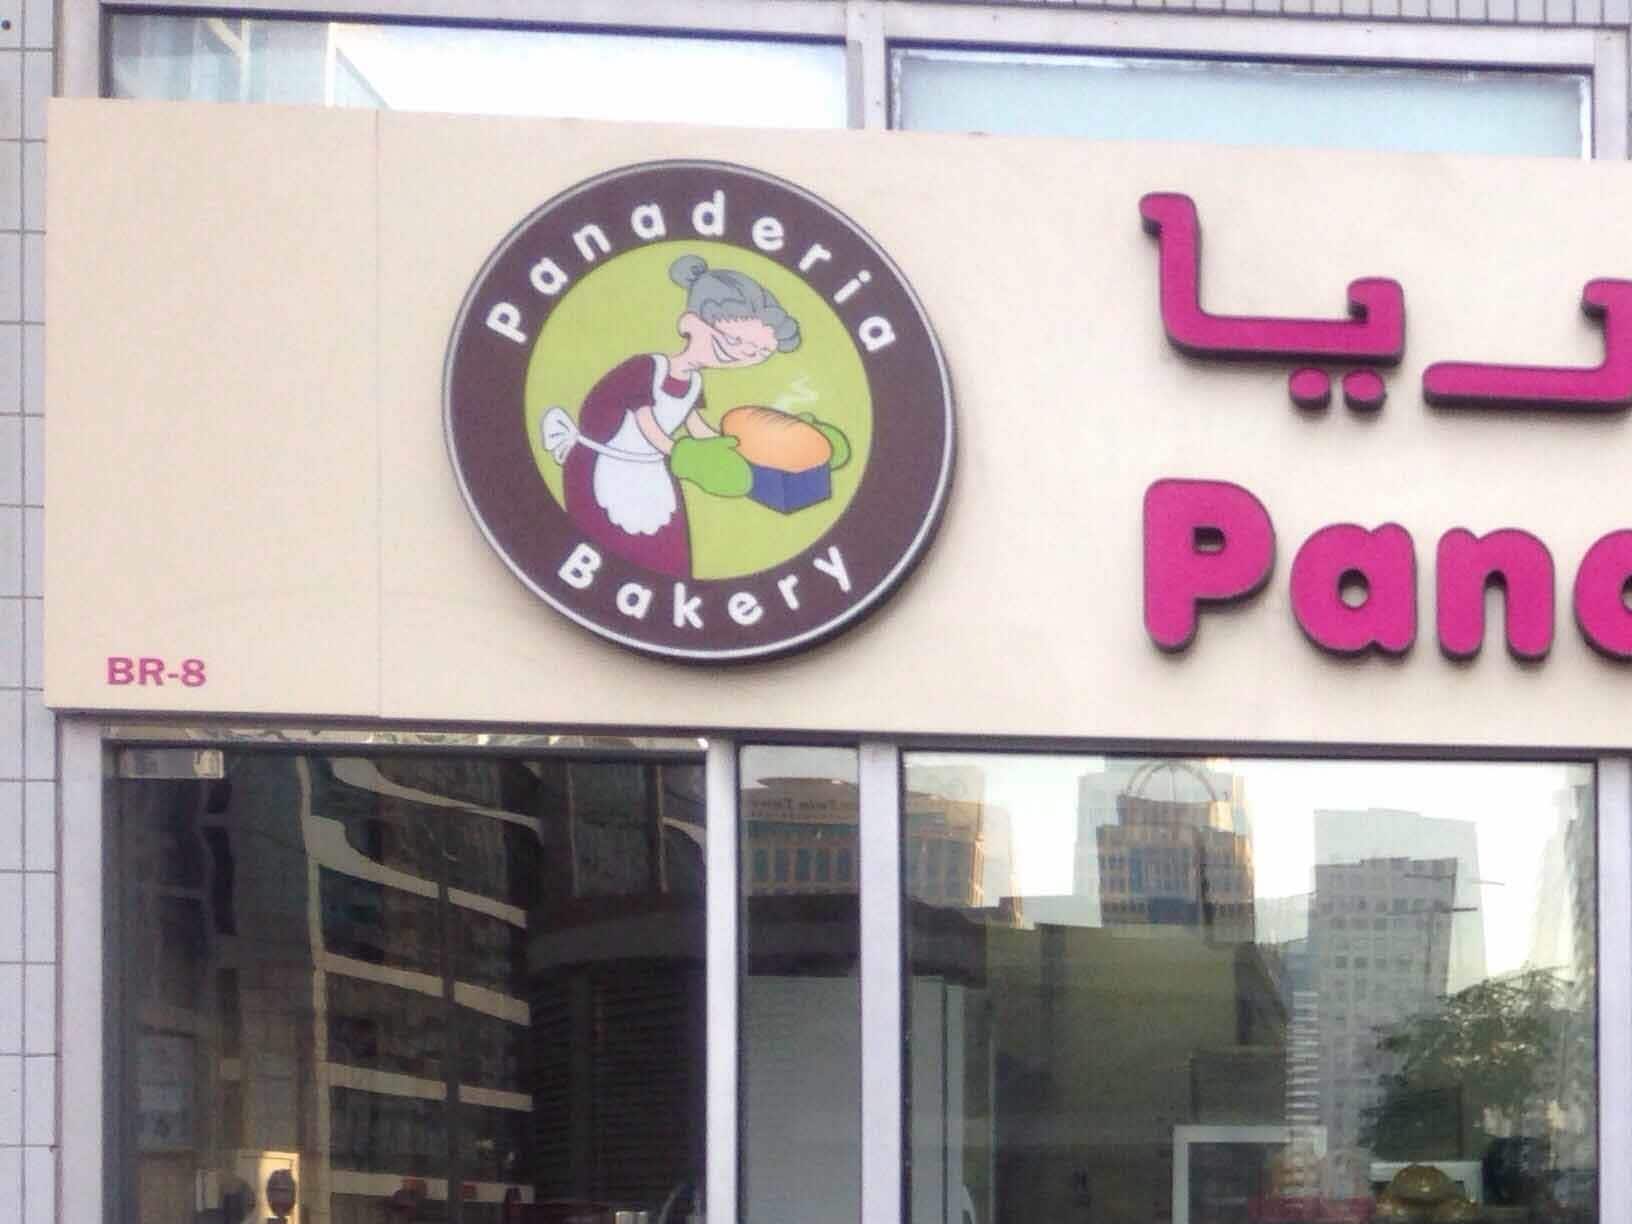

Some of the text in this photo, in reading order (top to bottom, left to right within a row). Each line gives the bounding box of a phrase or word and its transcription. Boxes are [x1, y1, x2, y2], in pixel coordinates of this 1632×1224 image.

[485, 189, 897, 344] Panaderia
[557, 542, 853, 630] Bakery
[106, 656, 207, 687] BR-8
